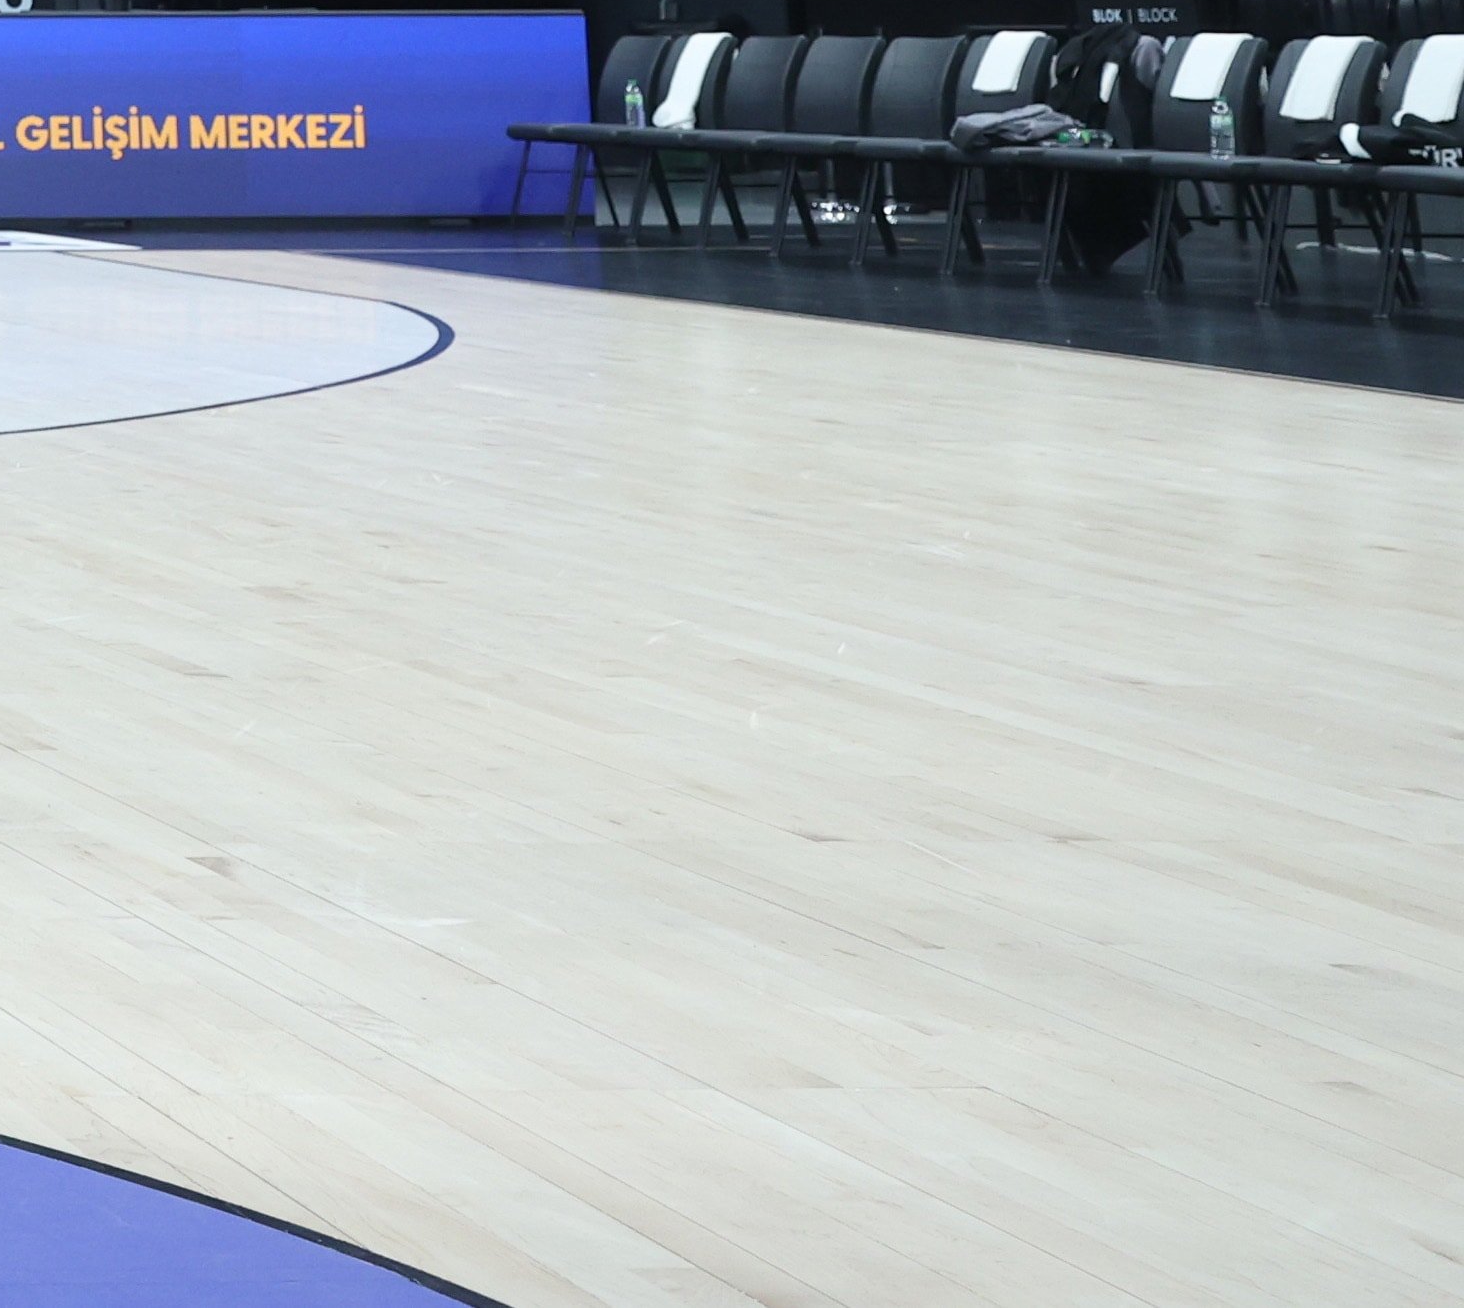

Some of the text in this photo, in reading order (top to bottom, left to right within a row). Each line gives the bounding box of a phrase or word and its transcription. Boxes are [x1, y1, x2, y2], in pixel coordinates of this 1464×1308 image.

[1137, 7, 1178, 23] BLOCK
[15, 105, 179, 161] GELİŞİM
[189, 104, 366, 150] MERKEZİ
